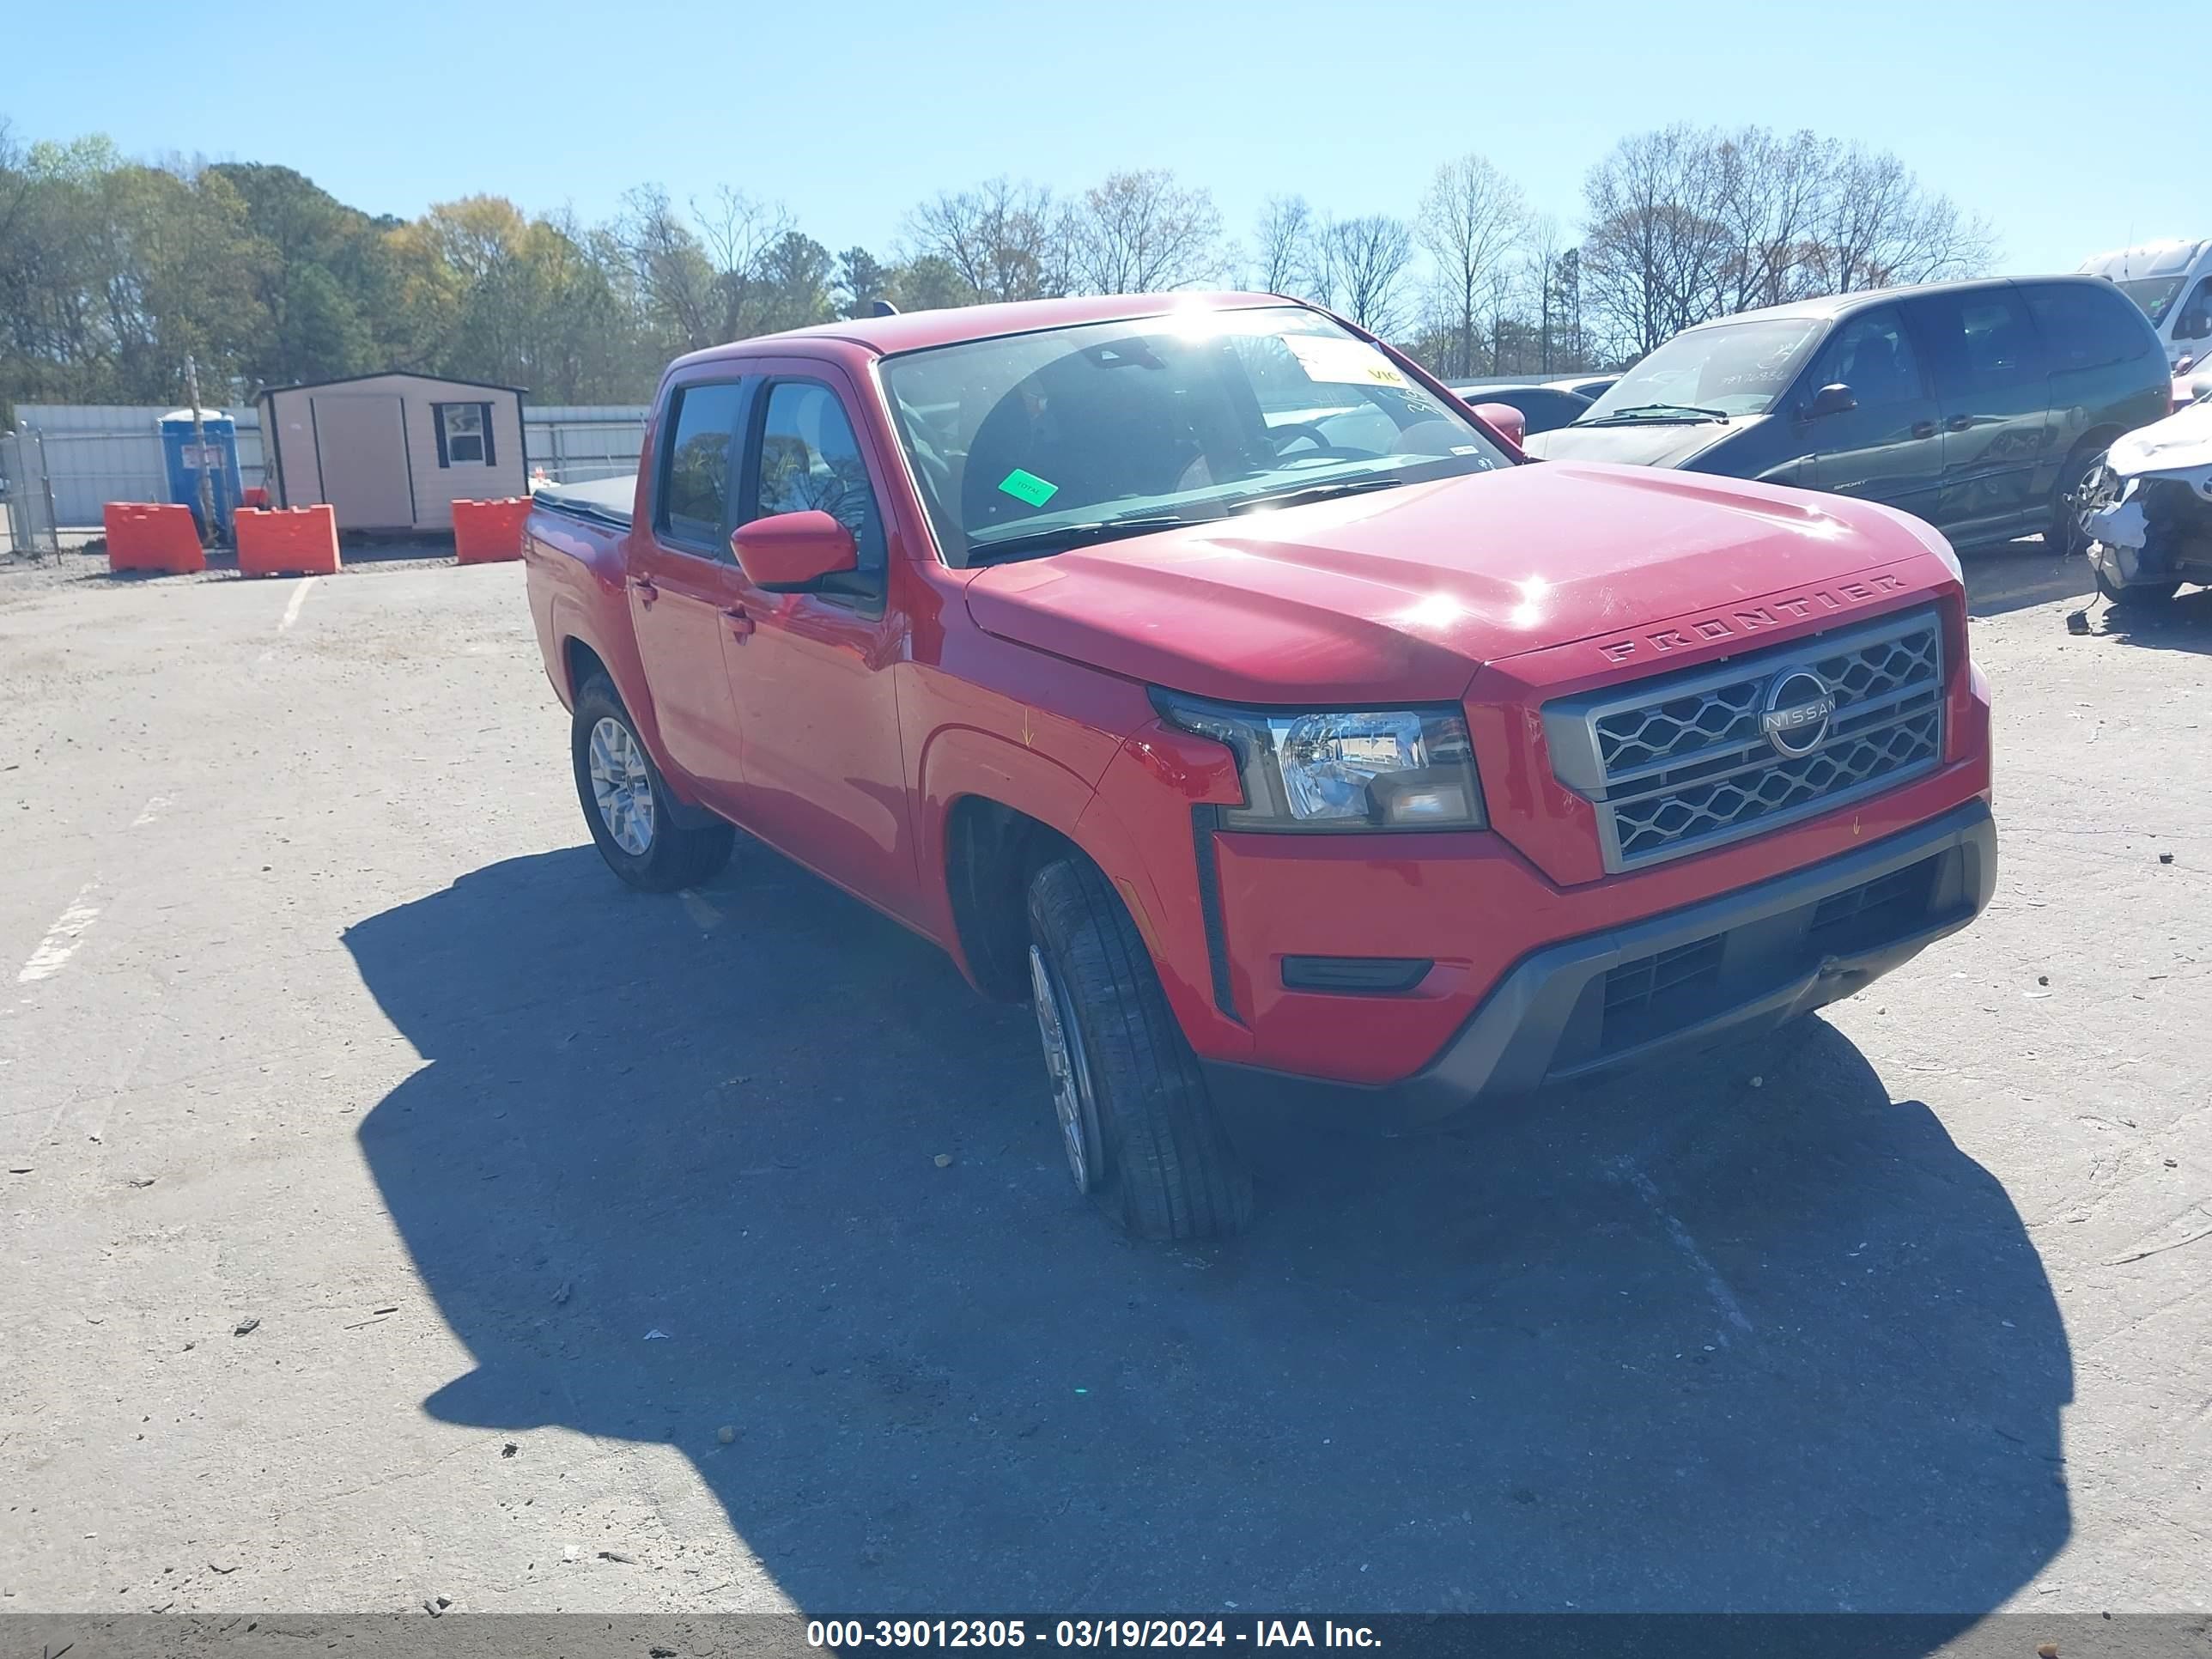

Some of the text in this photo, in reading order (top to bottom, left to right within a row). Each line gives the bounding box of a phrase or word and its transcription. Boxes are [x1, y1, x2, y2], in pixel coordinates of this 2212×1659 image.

[1367, 368, 1401, 381] VIC
[1833, 479, 1869, 489] SPORT
[1599, 574, 1908, 663] FRONTIER
[1765, 699, 1836, 730] NISSAN
